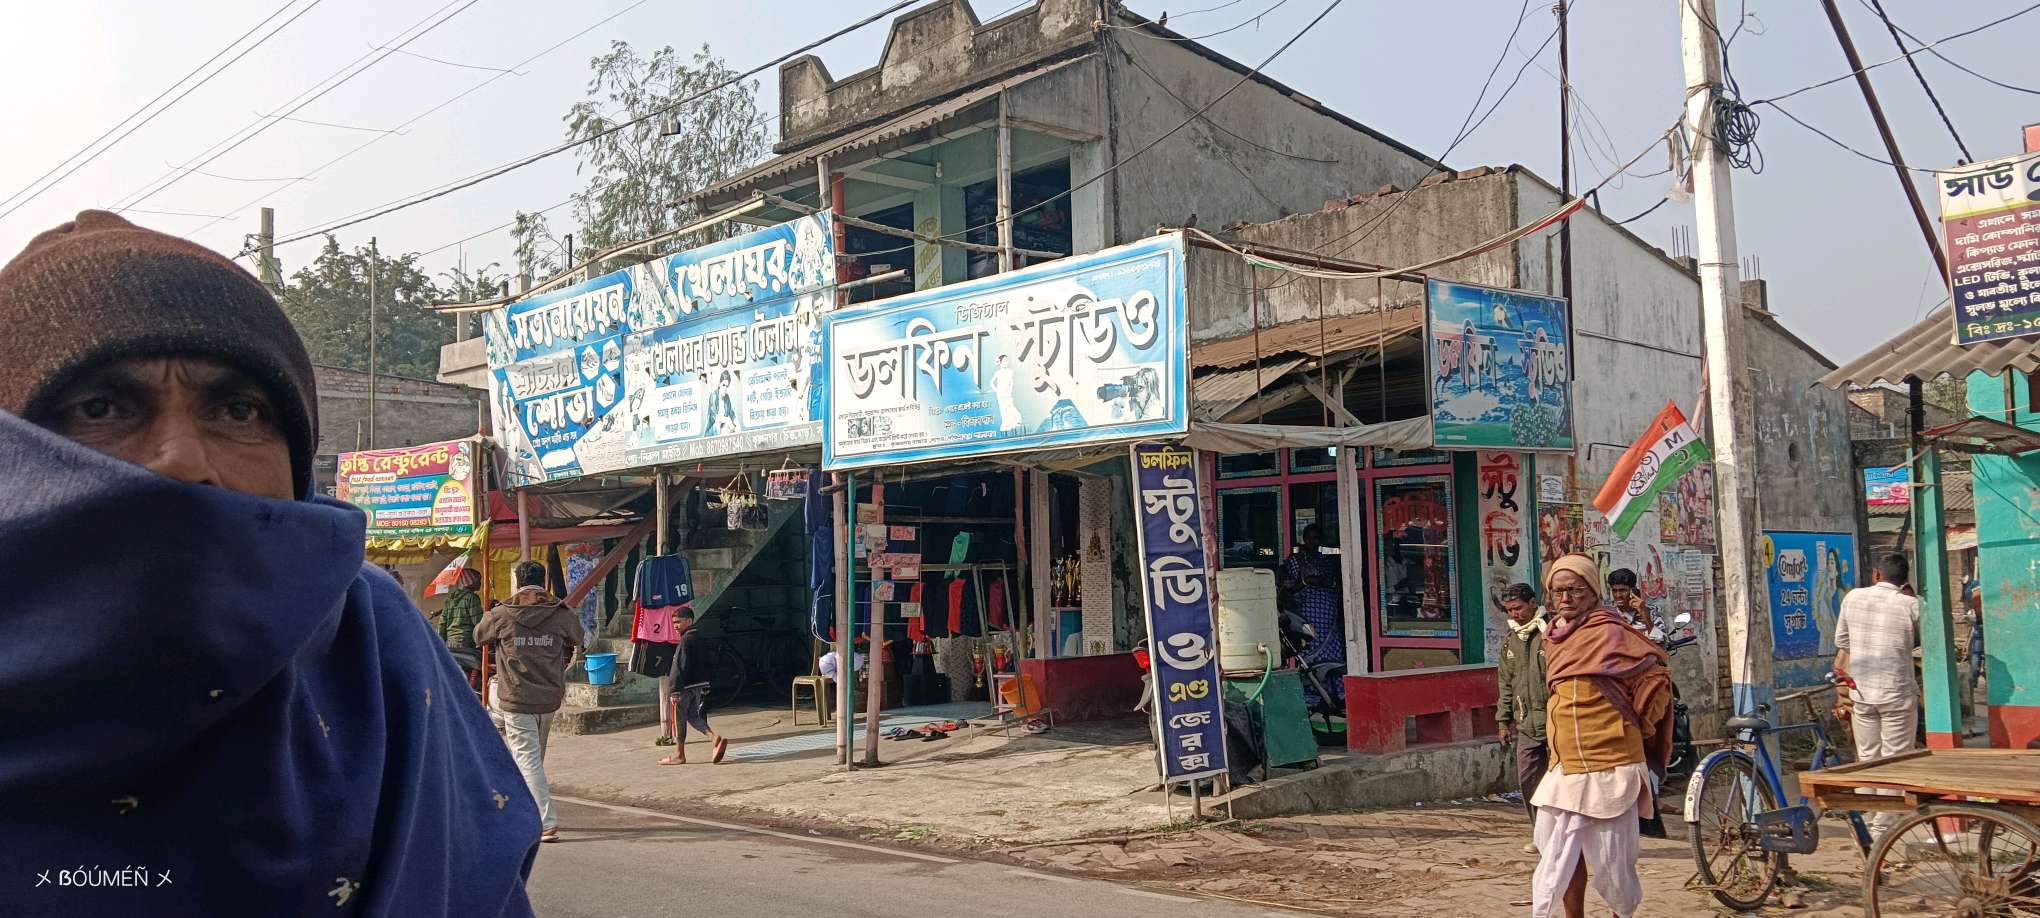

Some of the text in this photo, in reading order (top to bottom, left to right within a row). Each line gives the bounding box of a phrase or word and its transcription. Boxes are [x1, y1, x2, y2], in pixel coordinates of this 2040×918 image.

[1978, 214, 2015, 229] এখানে
[1955, 232, 1980, 246] দামি
[1966, 238, 2039, 259] কিপ্যাড ফোন
[673, 239, 789, 314] খেলাঘর
[1955, 275, 1981, 287] LED
[1964, 289, 1975, 300] ও
[1977, 281, 2017, 298] যাবতীয়
[1965, 301, 1996, 318] সুলভ
[1999, 296, 2028, 313] মূল্যে
[843, 289, 1160, 401] ডলফিন স্টুডিও
[650, 335, 705, 381] খেলাঘর
[340, 453, 369, 478] তৃপ্তি
[1140, 446, 1193, 470] ডলফিন
[1778, 554, 1808, 579] Comfort
[674, 583, 689, 598] 19
[653, 623, 661, 635] 2
